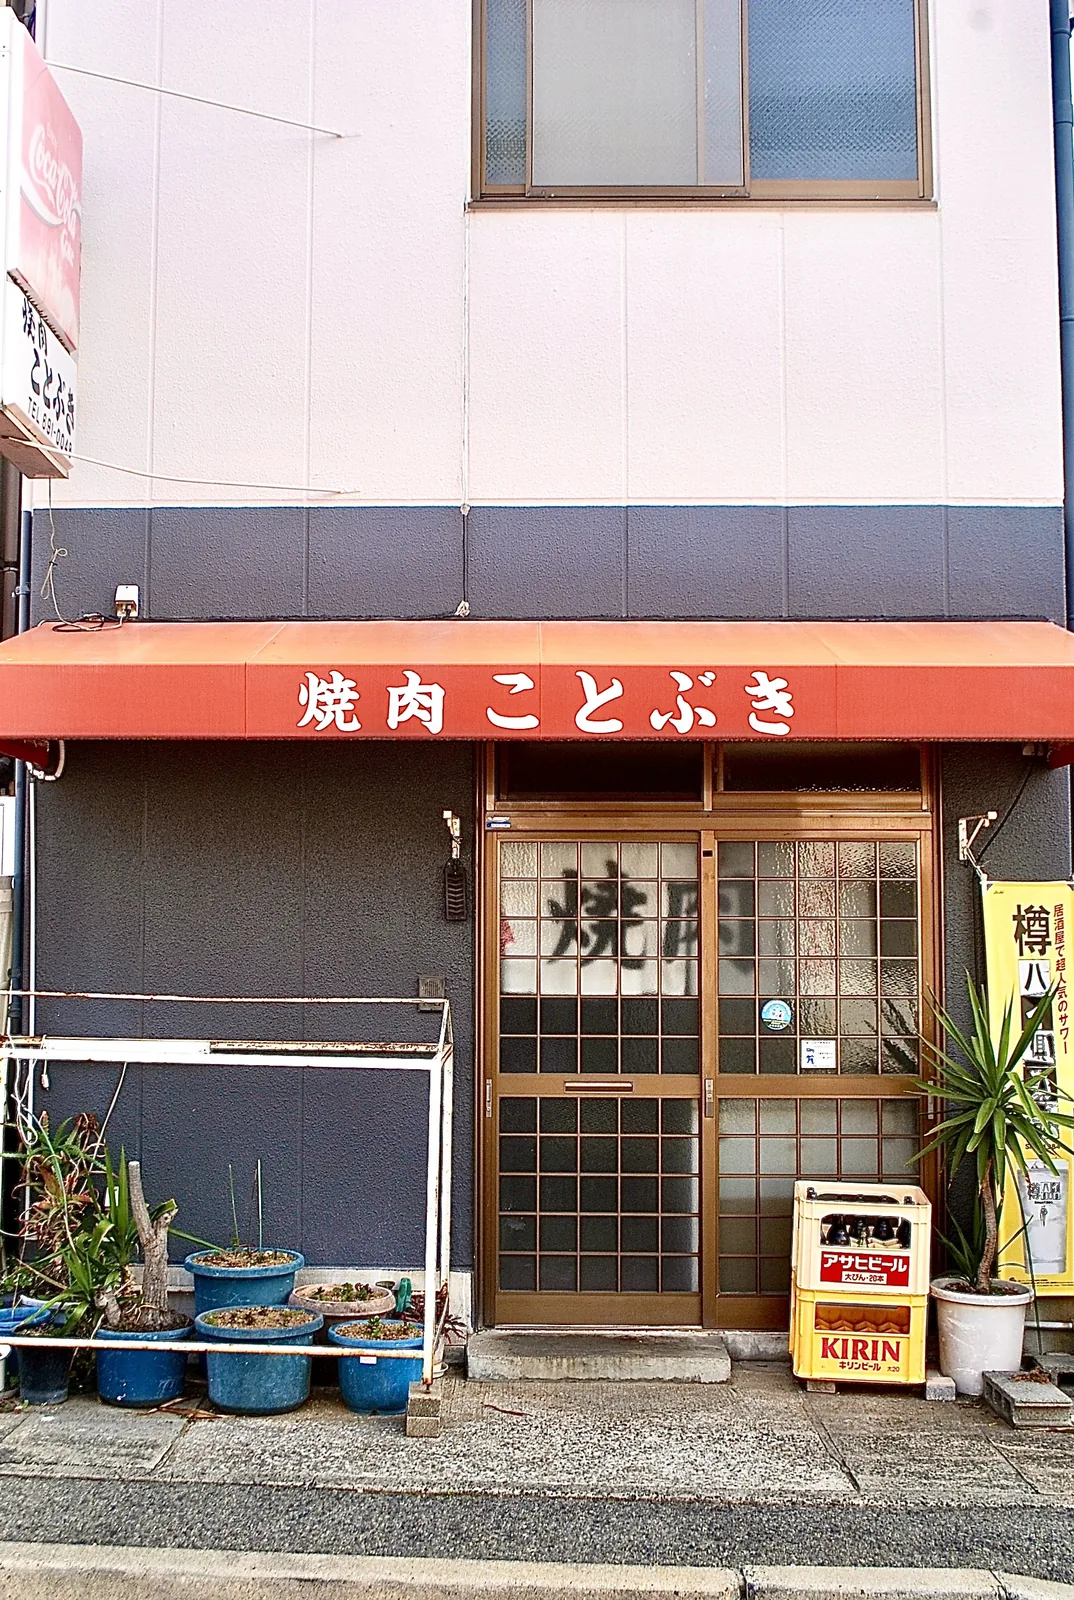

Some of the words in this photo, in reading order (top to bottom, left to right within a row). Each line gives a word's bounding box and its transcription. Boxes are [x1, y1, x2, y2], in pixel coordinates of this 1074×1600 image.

[30, 347, 75, 436] ことぶき
[28, 396, 40, 425] TEL
[1053, 903, 1069, 1055] 居酒屋で超人気のサワー
[823, 1253, 908, 1273] アサヒビール
[821, 1337, 901, 1363] KIRIN
[838, 1361, 881, 1372] キリンビール
